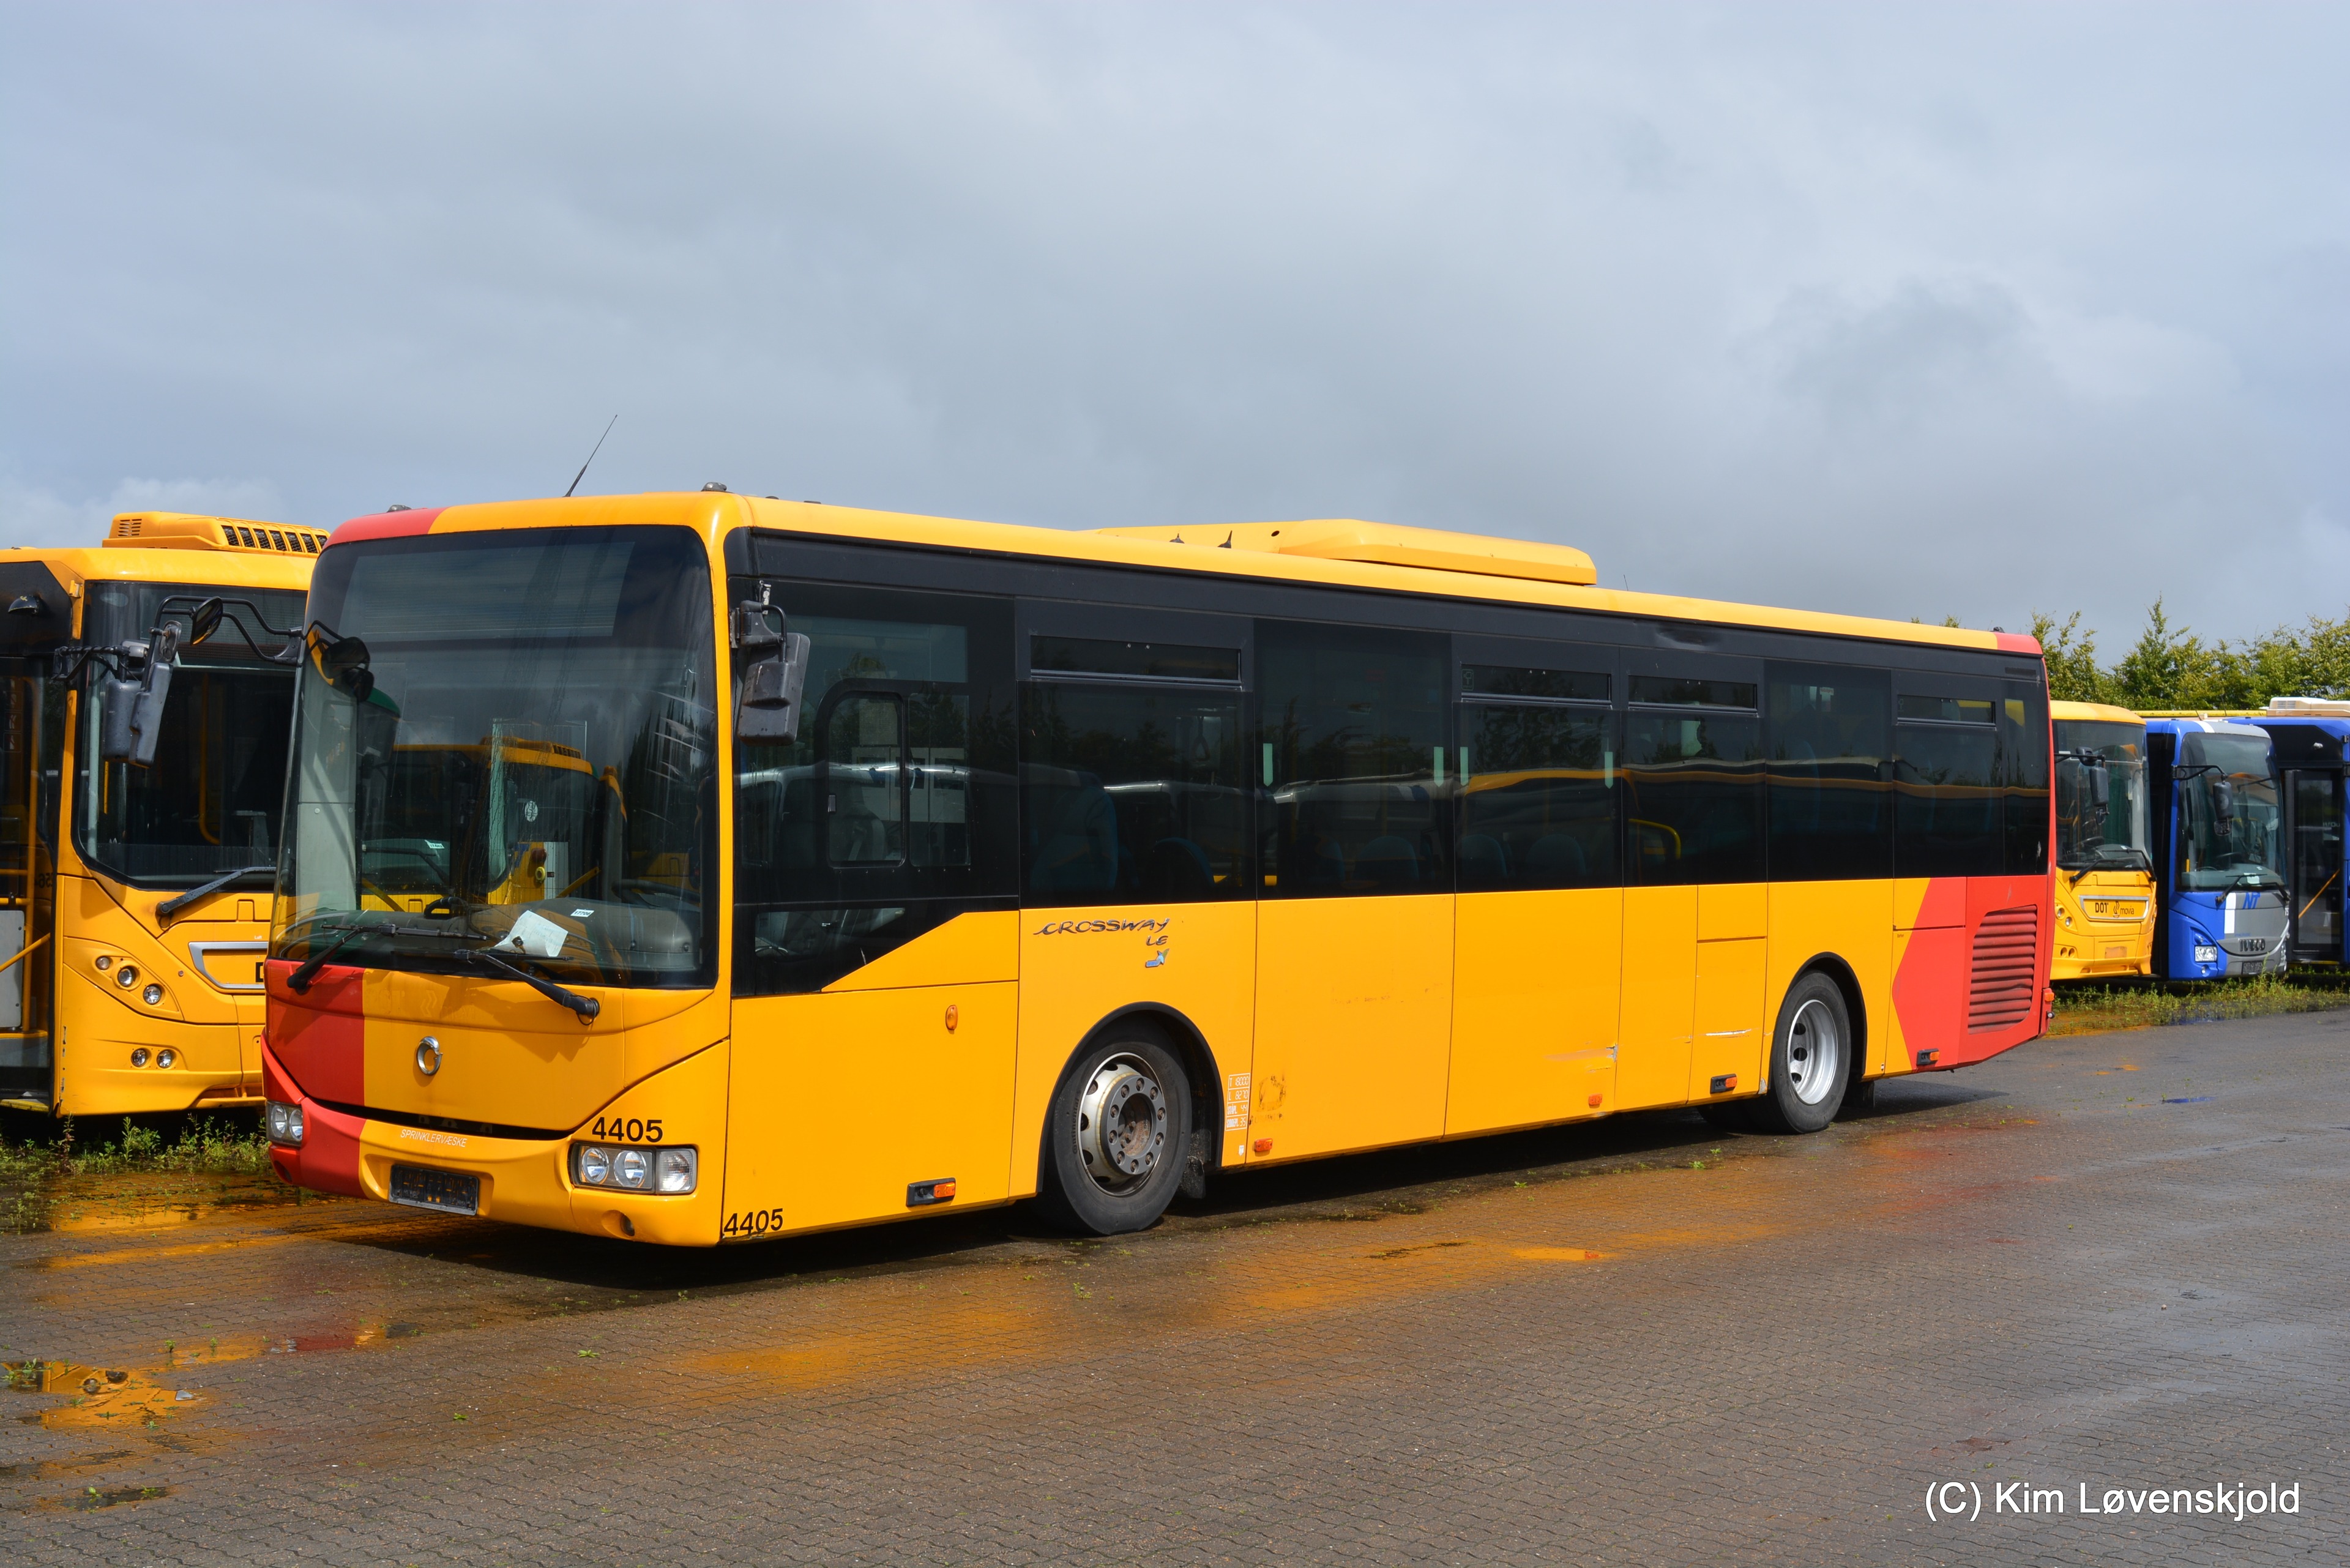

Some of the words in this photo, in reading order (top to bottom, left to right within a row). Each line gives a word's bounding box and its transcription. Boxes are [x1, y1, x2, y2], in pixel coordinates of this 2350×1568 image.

[2095, 902, 2109, 913] DOT
[2242, 892, 2261, 909] NT
[2120, 906, 2135, 914] movia
[1033, 918, 1170, 935] CROSSWAY
[1146, 935, 1168, 946] LE
[2239, 938, 2266, 952] IVECO
[1235, 1089, 1248, 1100] 8270
[1240, 1117, 1246, 1127] 35
[592, 1116, 663, 1143] 4405
[400, 1129, 468, 1148] SPRINKLERVÆSKE
[723, 1208, 783, 1236] 4405
